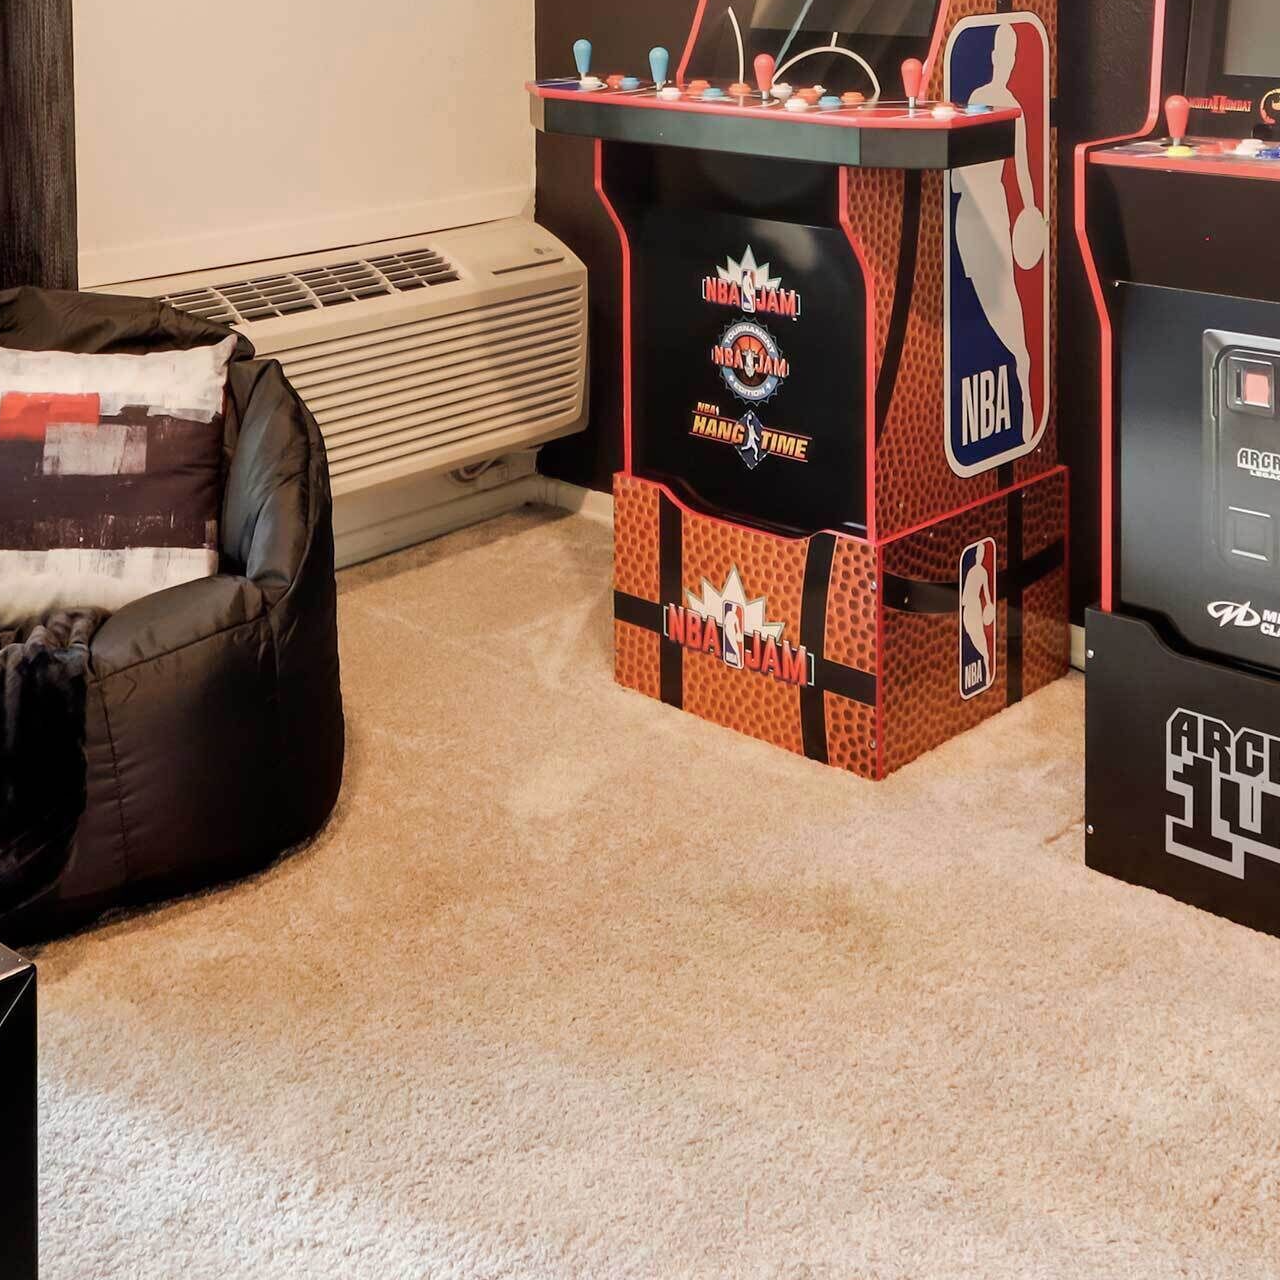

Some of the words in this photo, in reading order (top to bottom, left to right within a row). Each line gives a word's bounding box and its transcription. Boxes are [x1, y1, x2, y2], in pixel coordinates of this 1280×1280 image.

[705, 276, 740, 307] NBA
[756, 285, 797, 317] JAM
[724, 325, 775, 354] TOURNAMENT
[715, 345, 744, 369] NBA
[755, 354, 787, 378] JAM
[697, 402, 716, 415] NBA
[962, 365, 1011, 447] NBA
[692, 415, 746, 444] HANG
[760, 430, 809, 459] TIME
[668, 603, 722, 658] NBA
[745, 630, 808, 688] JAM
[965, 660, 983, 690] NBA
